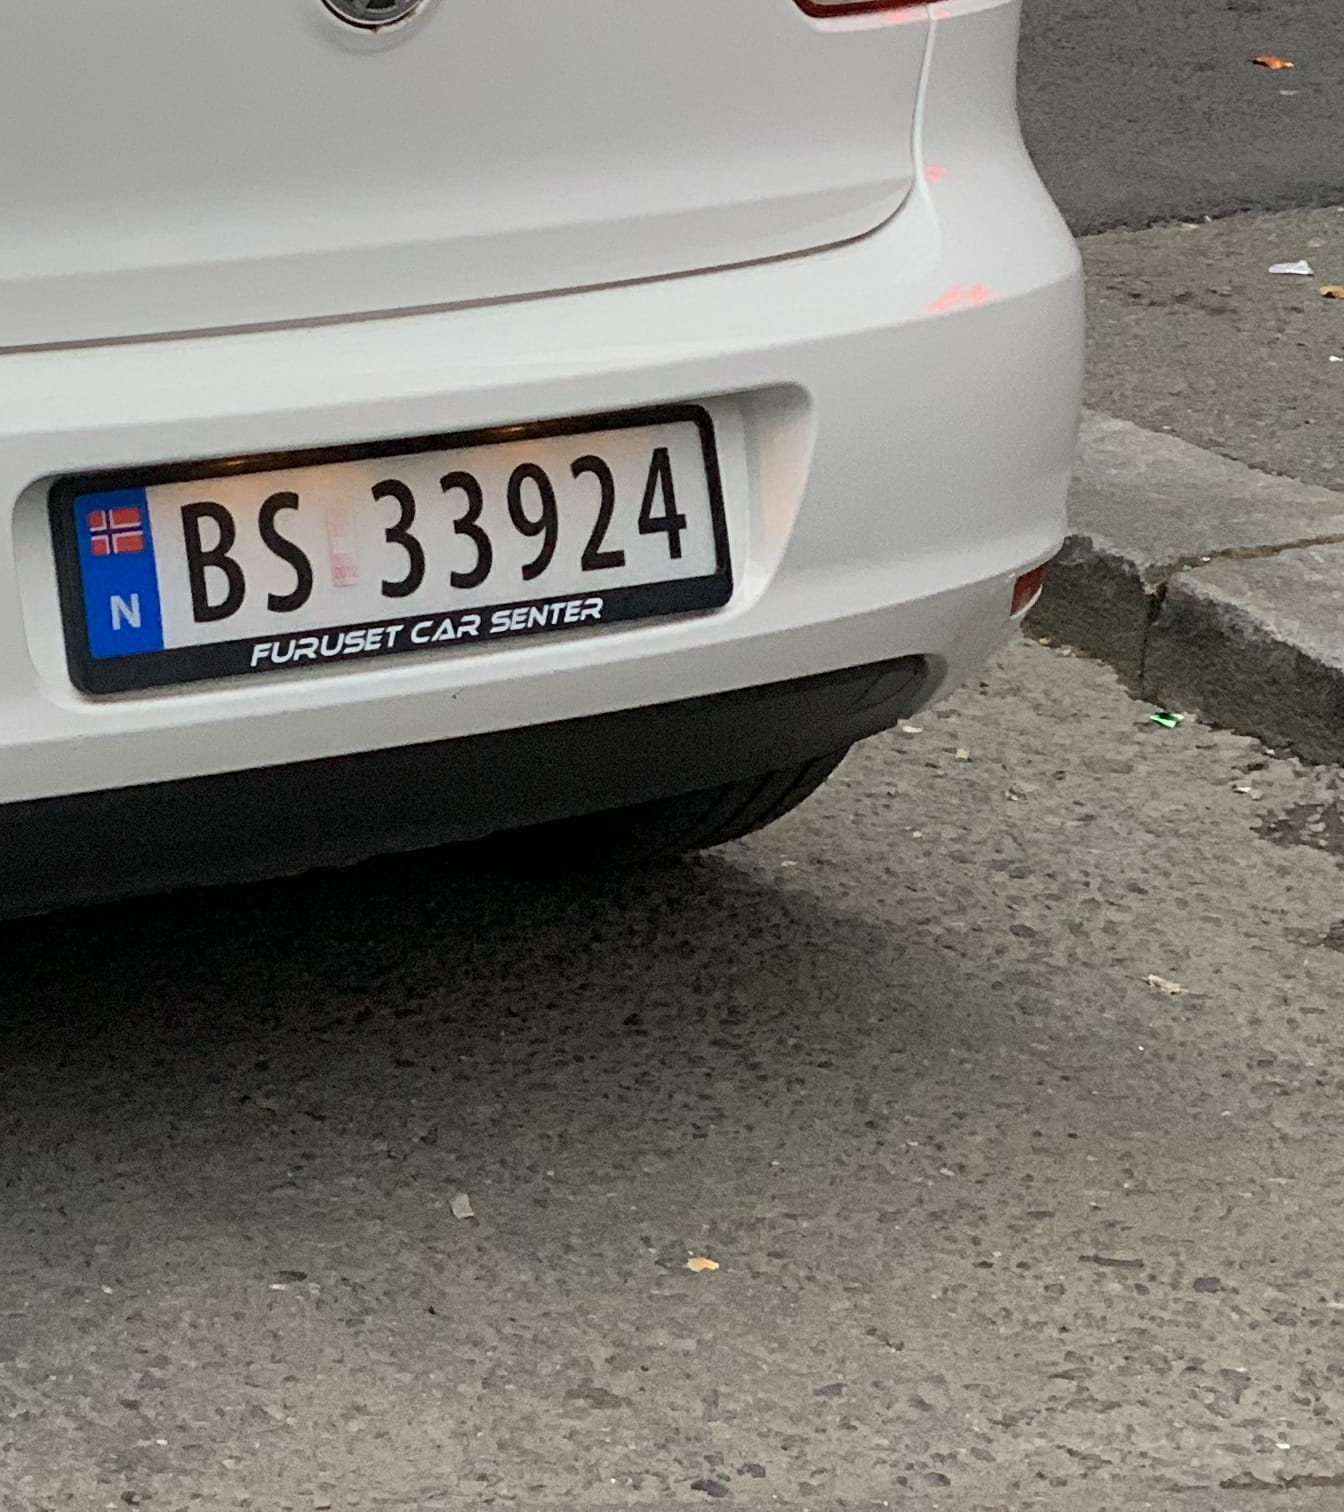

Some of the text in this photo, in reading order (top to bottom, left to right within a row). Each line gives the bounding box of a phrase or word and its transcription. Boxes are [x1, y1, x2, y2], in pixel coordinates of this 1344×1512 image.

[180, 446, 687, 625] BS 33924
[110, 592, 143, 631] N
[250, 597, 604, 668] FURUSET CAR SENTER
